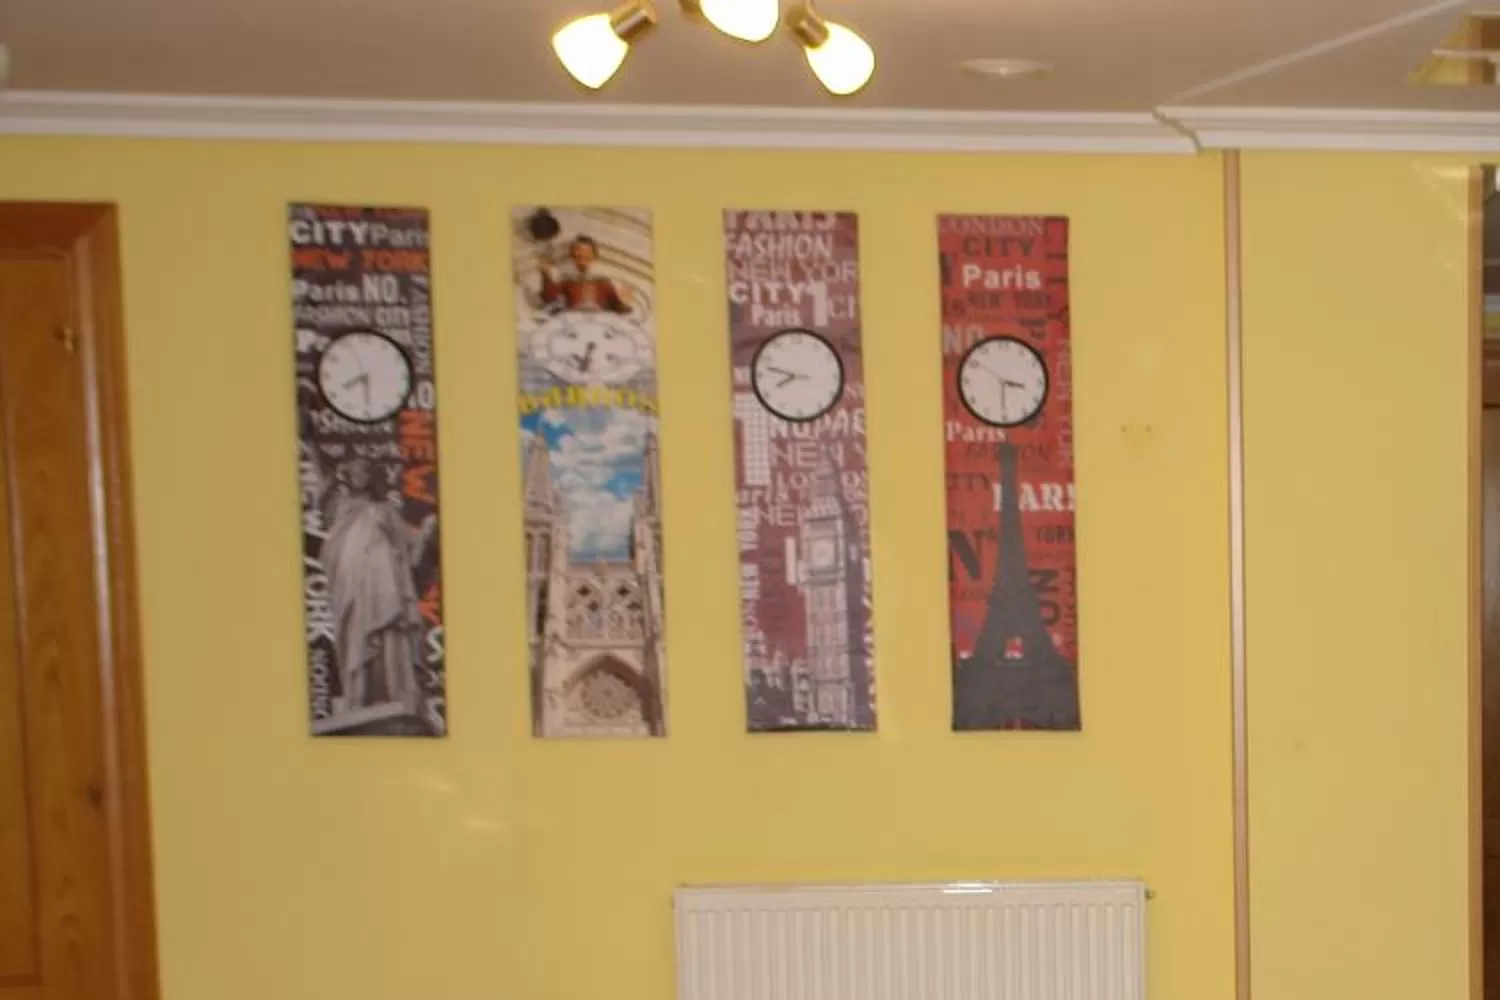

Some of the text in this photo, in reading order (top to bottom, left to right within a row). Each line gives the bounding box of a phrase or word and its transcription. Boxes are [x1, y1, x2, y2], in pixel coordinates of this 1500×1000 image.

[290, 219, 368, 246] CITY
[727, 232, 834, 260] FASHION
[962, 236, 1035, 258] CITY
[962, 263, 1042, 290] Paris
[730, 281, 804, 305] CITY
